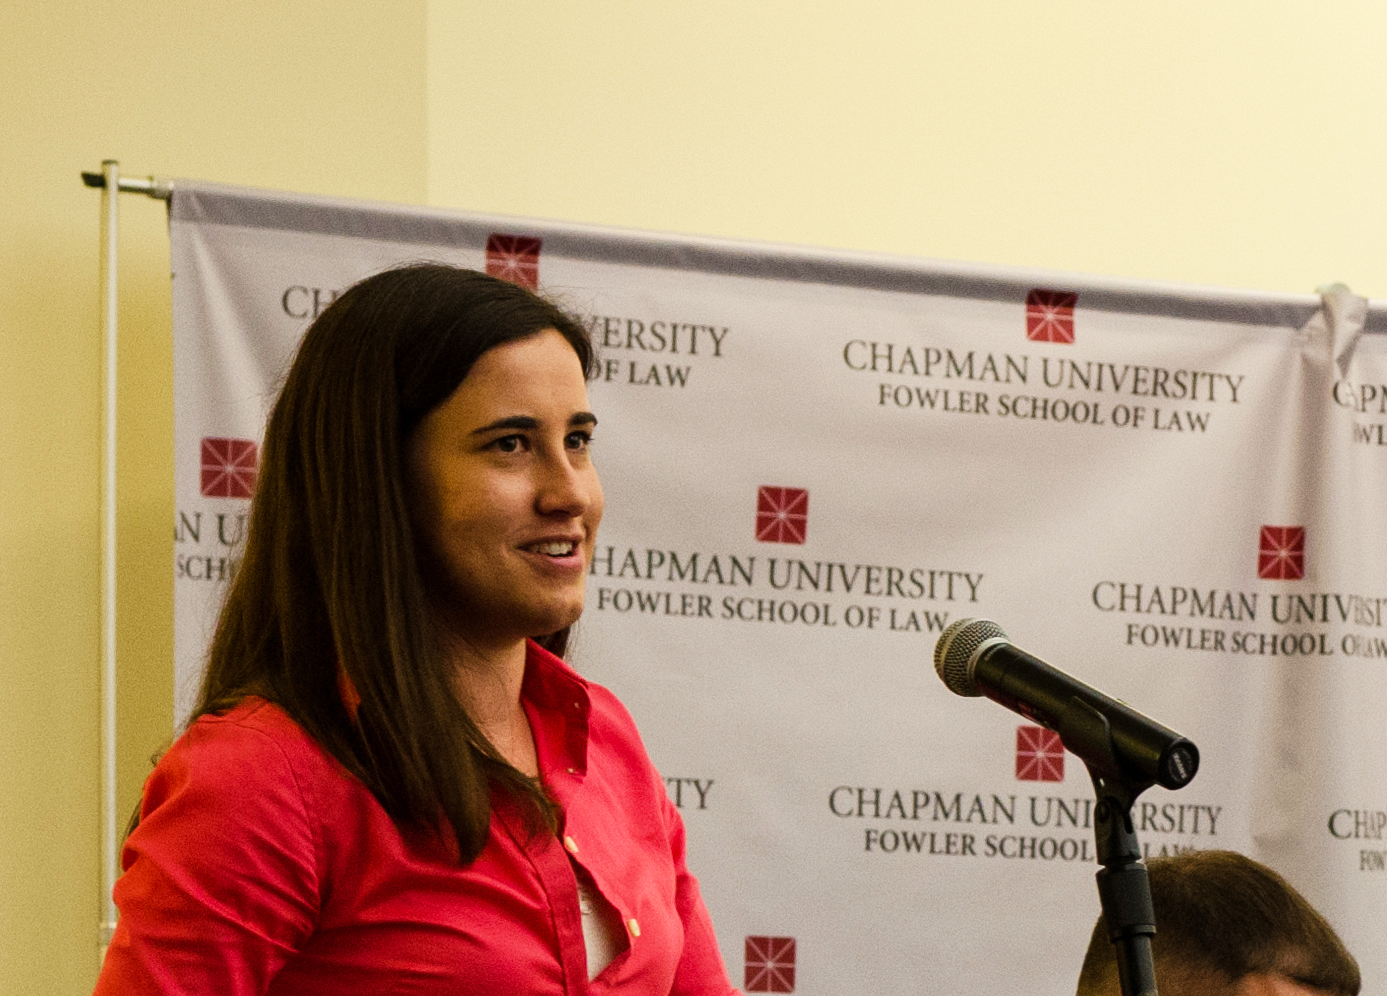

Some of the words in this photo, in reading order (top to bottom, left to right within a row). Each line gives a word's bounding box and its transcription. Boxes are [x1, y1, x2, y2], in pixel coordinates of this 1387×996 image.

[628, 361, 691, 388] LAW
[842, 338, 1029, 386] CHAPMAN
[1041, 357, 1246, 403] UNIVERSITY
[878, 383, 990, 416] FOWLER
[998, 394, 1105, 426] SCHOOL
[1111, 404, 1146, 428] OF
[1152, 407, 1211, 434] LAW
[589, 546, 756, 587] HAPMAN
[768, 557, 984, 603] UNIVERSITY
[597, 587, 713, 619] FOWLER
[721, 596, 837, 626] SCHOOL
[844, 604, 880, 630] OF
[889, 608, 949, 633] LAW
[1092, 580, 1259, 622] CHAPMAN
[1125, 623, 1226, 652] FOWLER
[1231, 630, 1334, 656] SCHOOL
[828, 785, 1017, 825] CHAPMAN
[1029, 796, 1222, 835] UNIRSITY
[864, 828, 977, 857] FOWLER
[984, 834, 1094, 862] SCHOOL
